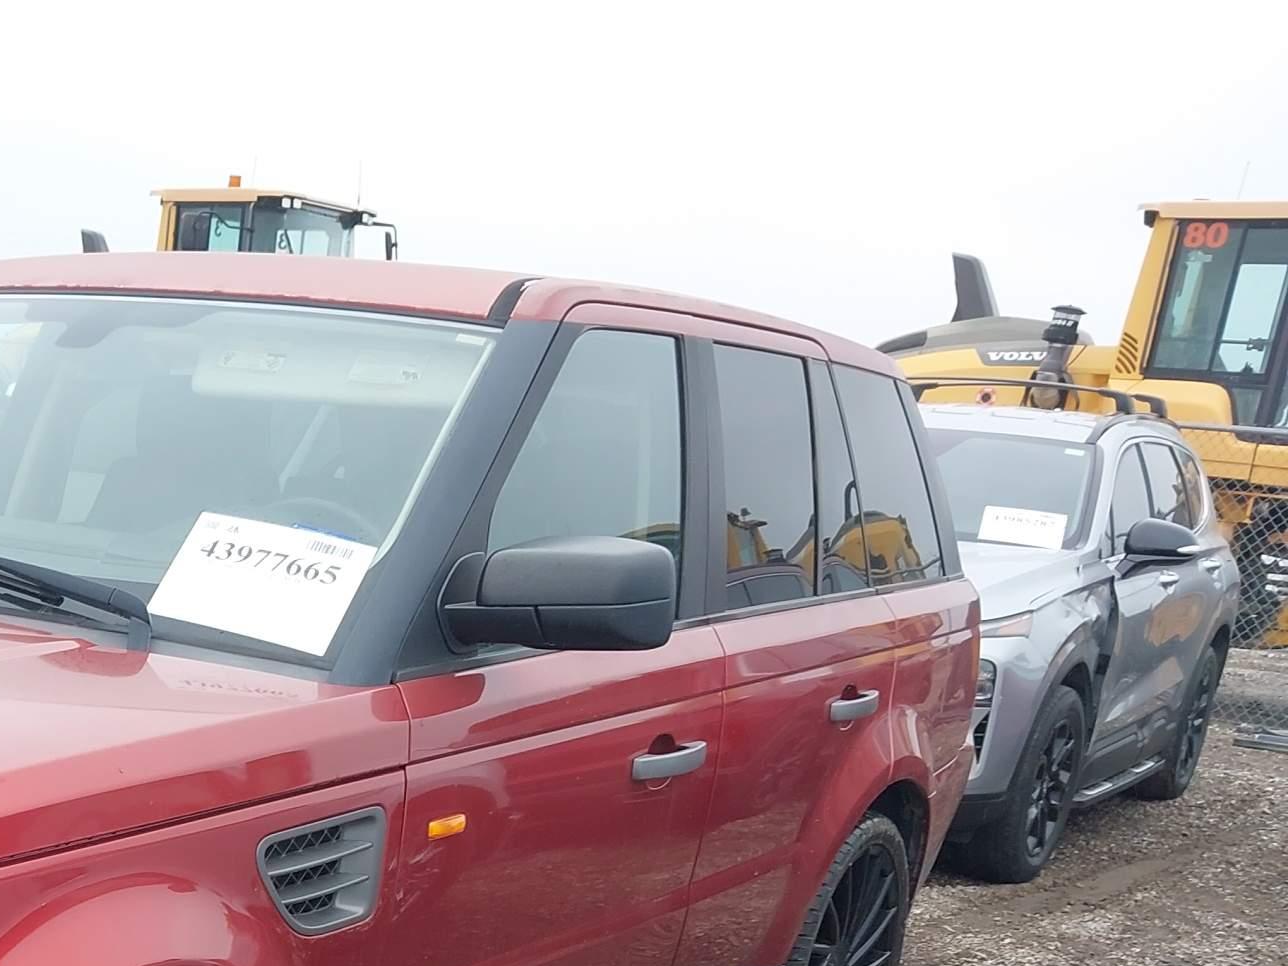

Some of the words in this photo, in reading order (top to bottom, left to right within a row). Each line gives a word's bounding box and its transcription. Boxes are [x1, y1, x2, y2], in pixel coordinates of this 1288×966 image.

[1182, 221, 1229, 248] 80
[987, 351, 1048, 361] VOLV
[200, 539, 342, 585] 43977665
